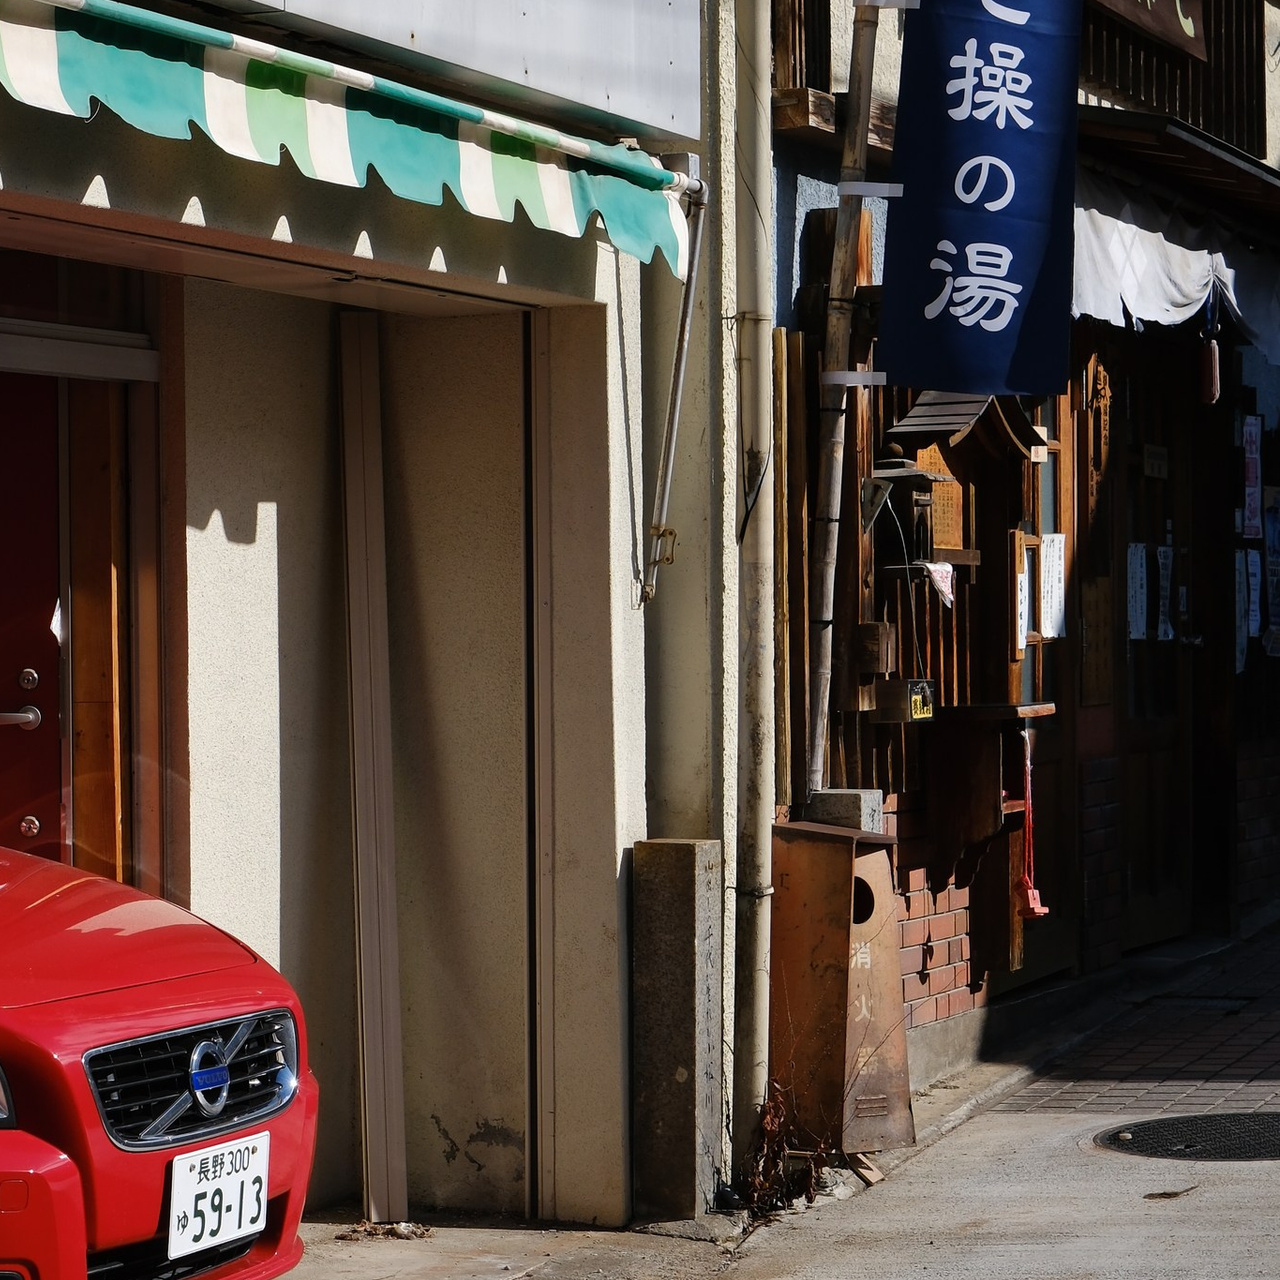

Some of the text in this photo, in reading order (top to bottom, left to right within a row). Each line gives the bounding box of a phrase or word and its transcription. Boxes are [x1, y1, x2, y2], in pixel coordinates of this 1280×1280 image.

[851, 941, 878, 1075] 消火器
[195, 1072, 228, 1087] VOLVO
[176, 1175, 263, 1243] ゆ 59-13
